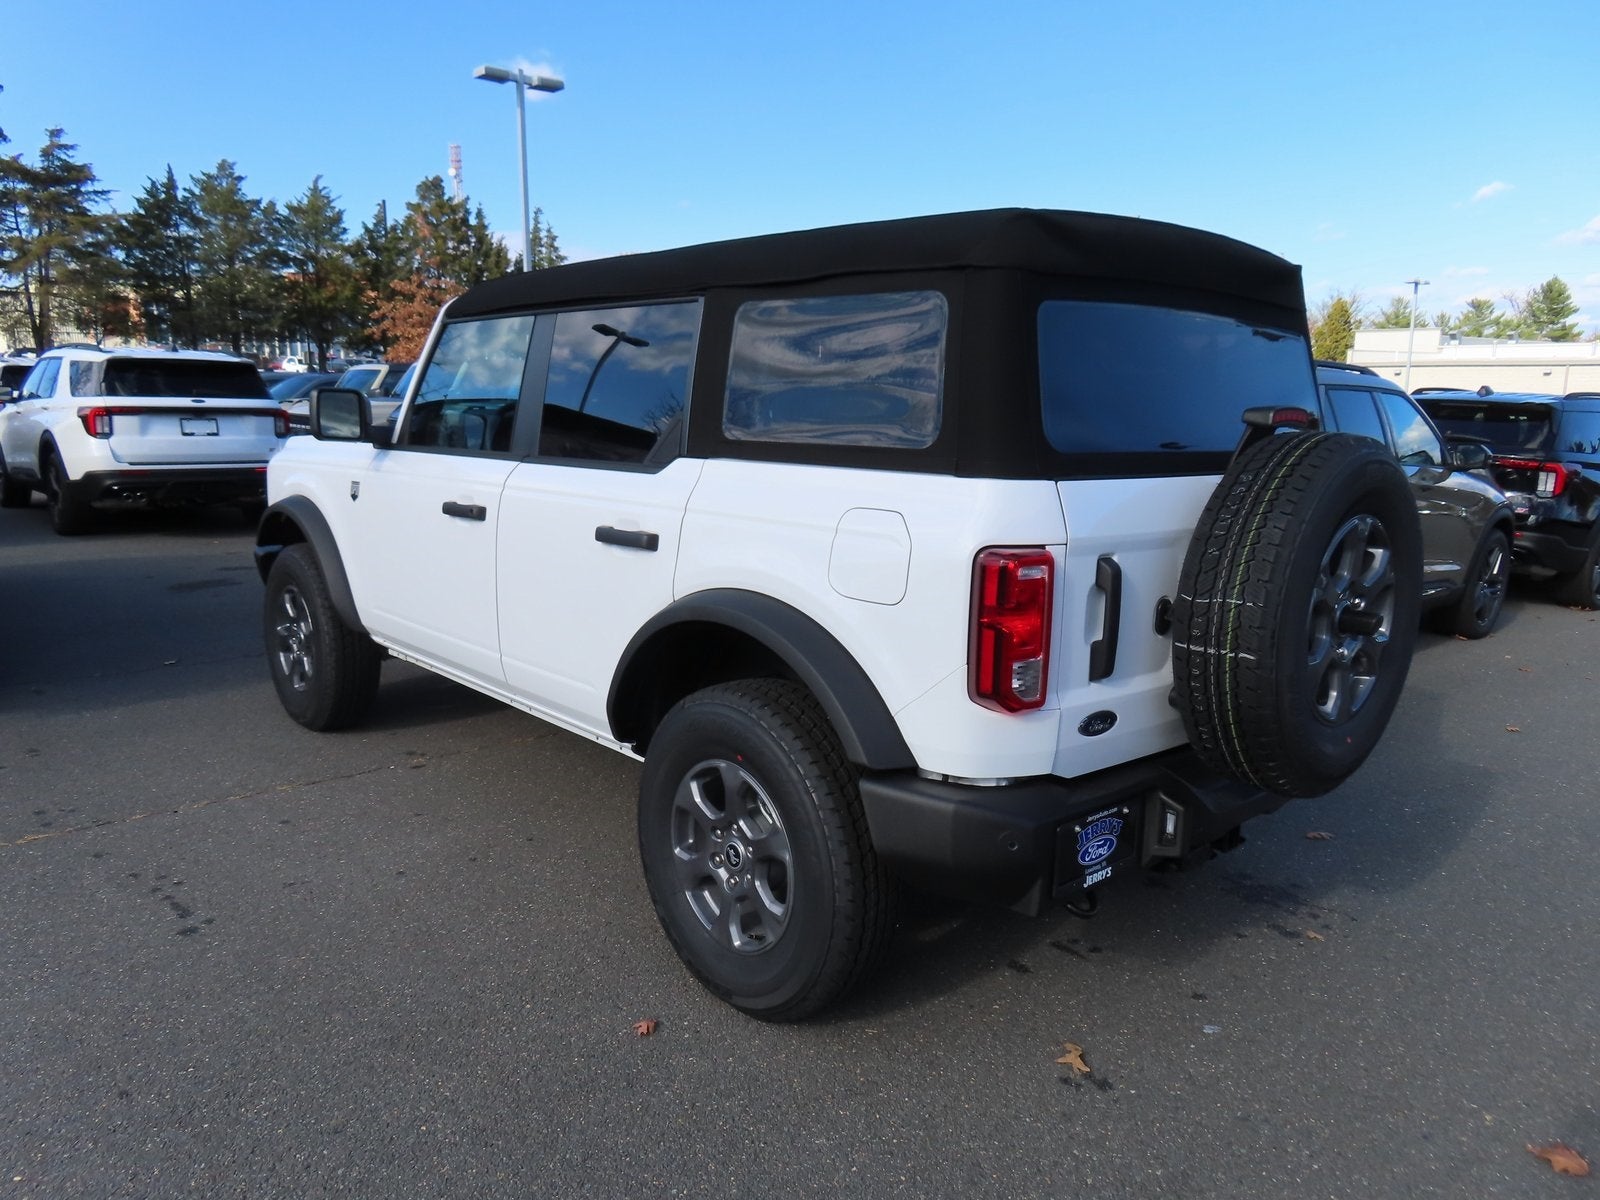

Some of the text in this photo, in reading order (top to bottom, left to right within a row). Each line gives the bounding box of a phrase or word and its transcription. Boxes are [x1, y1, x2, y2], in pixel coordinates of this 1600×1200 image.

[1076, 817, 1123, 851] JERRY'S
[1084, 839, 1110, 862] Ford
[1083, 866, 1112, 888] JERRY'S
